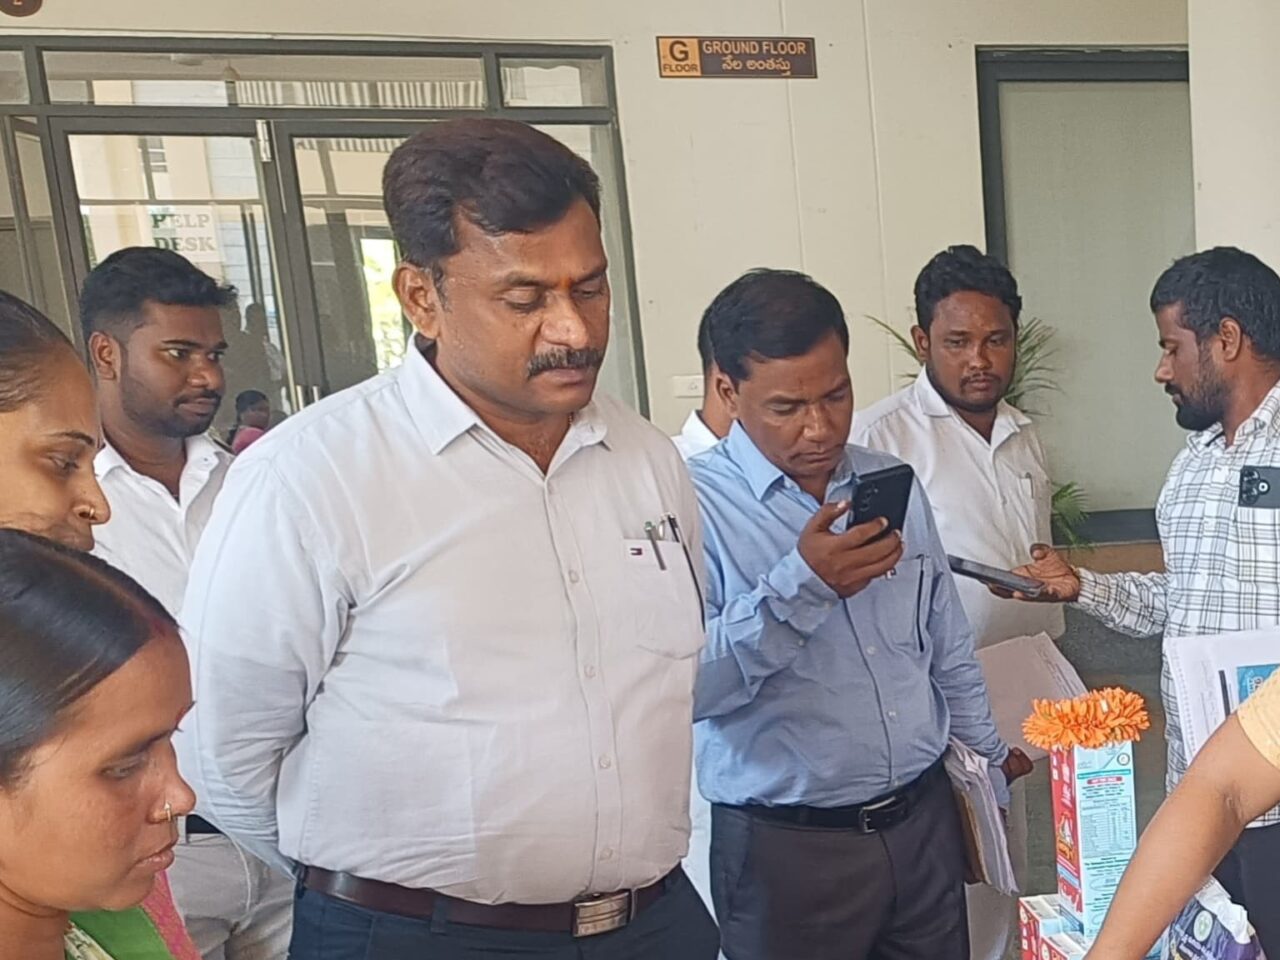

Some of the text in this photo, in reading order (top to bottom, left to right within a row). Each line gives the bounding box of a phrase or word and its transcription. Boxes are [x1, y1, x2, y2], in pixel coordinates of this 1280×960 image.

[669, 40, 689, 62] G
[702, 41, 806, 55] GROUND FLOOR
[663, 63, 698, 73] FLOOR
[722, 56, 791, 76] నేల అంతస్తు
